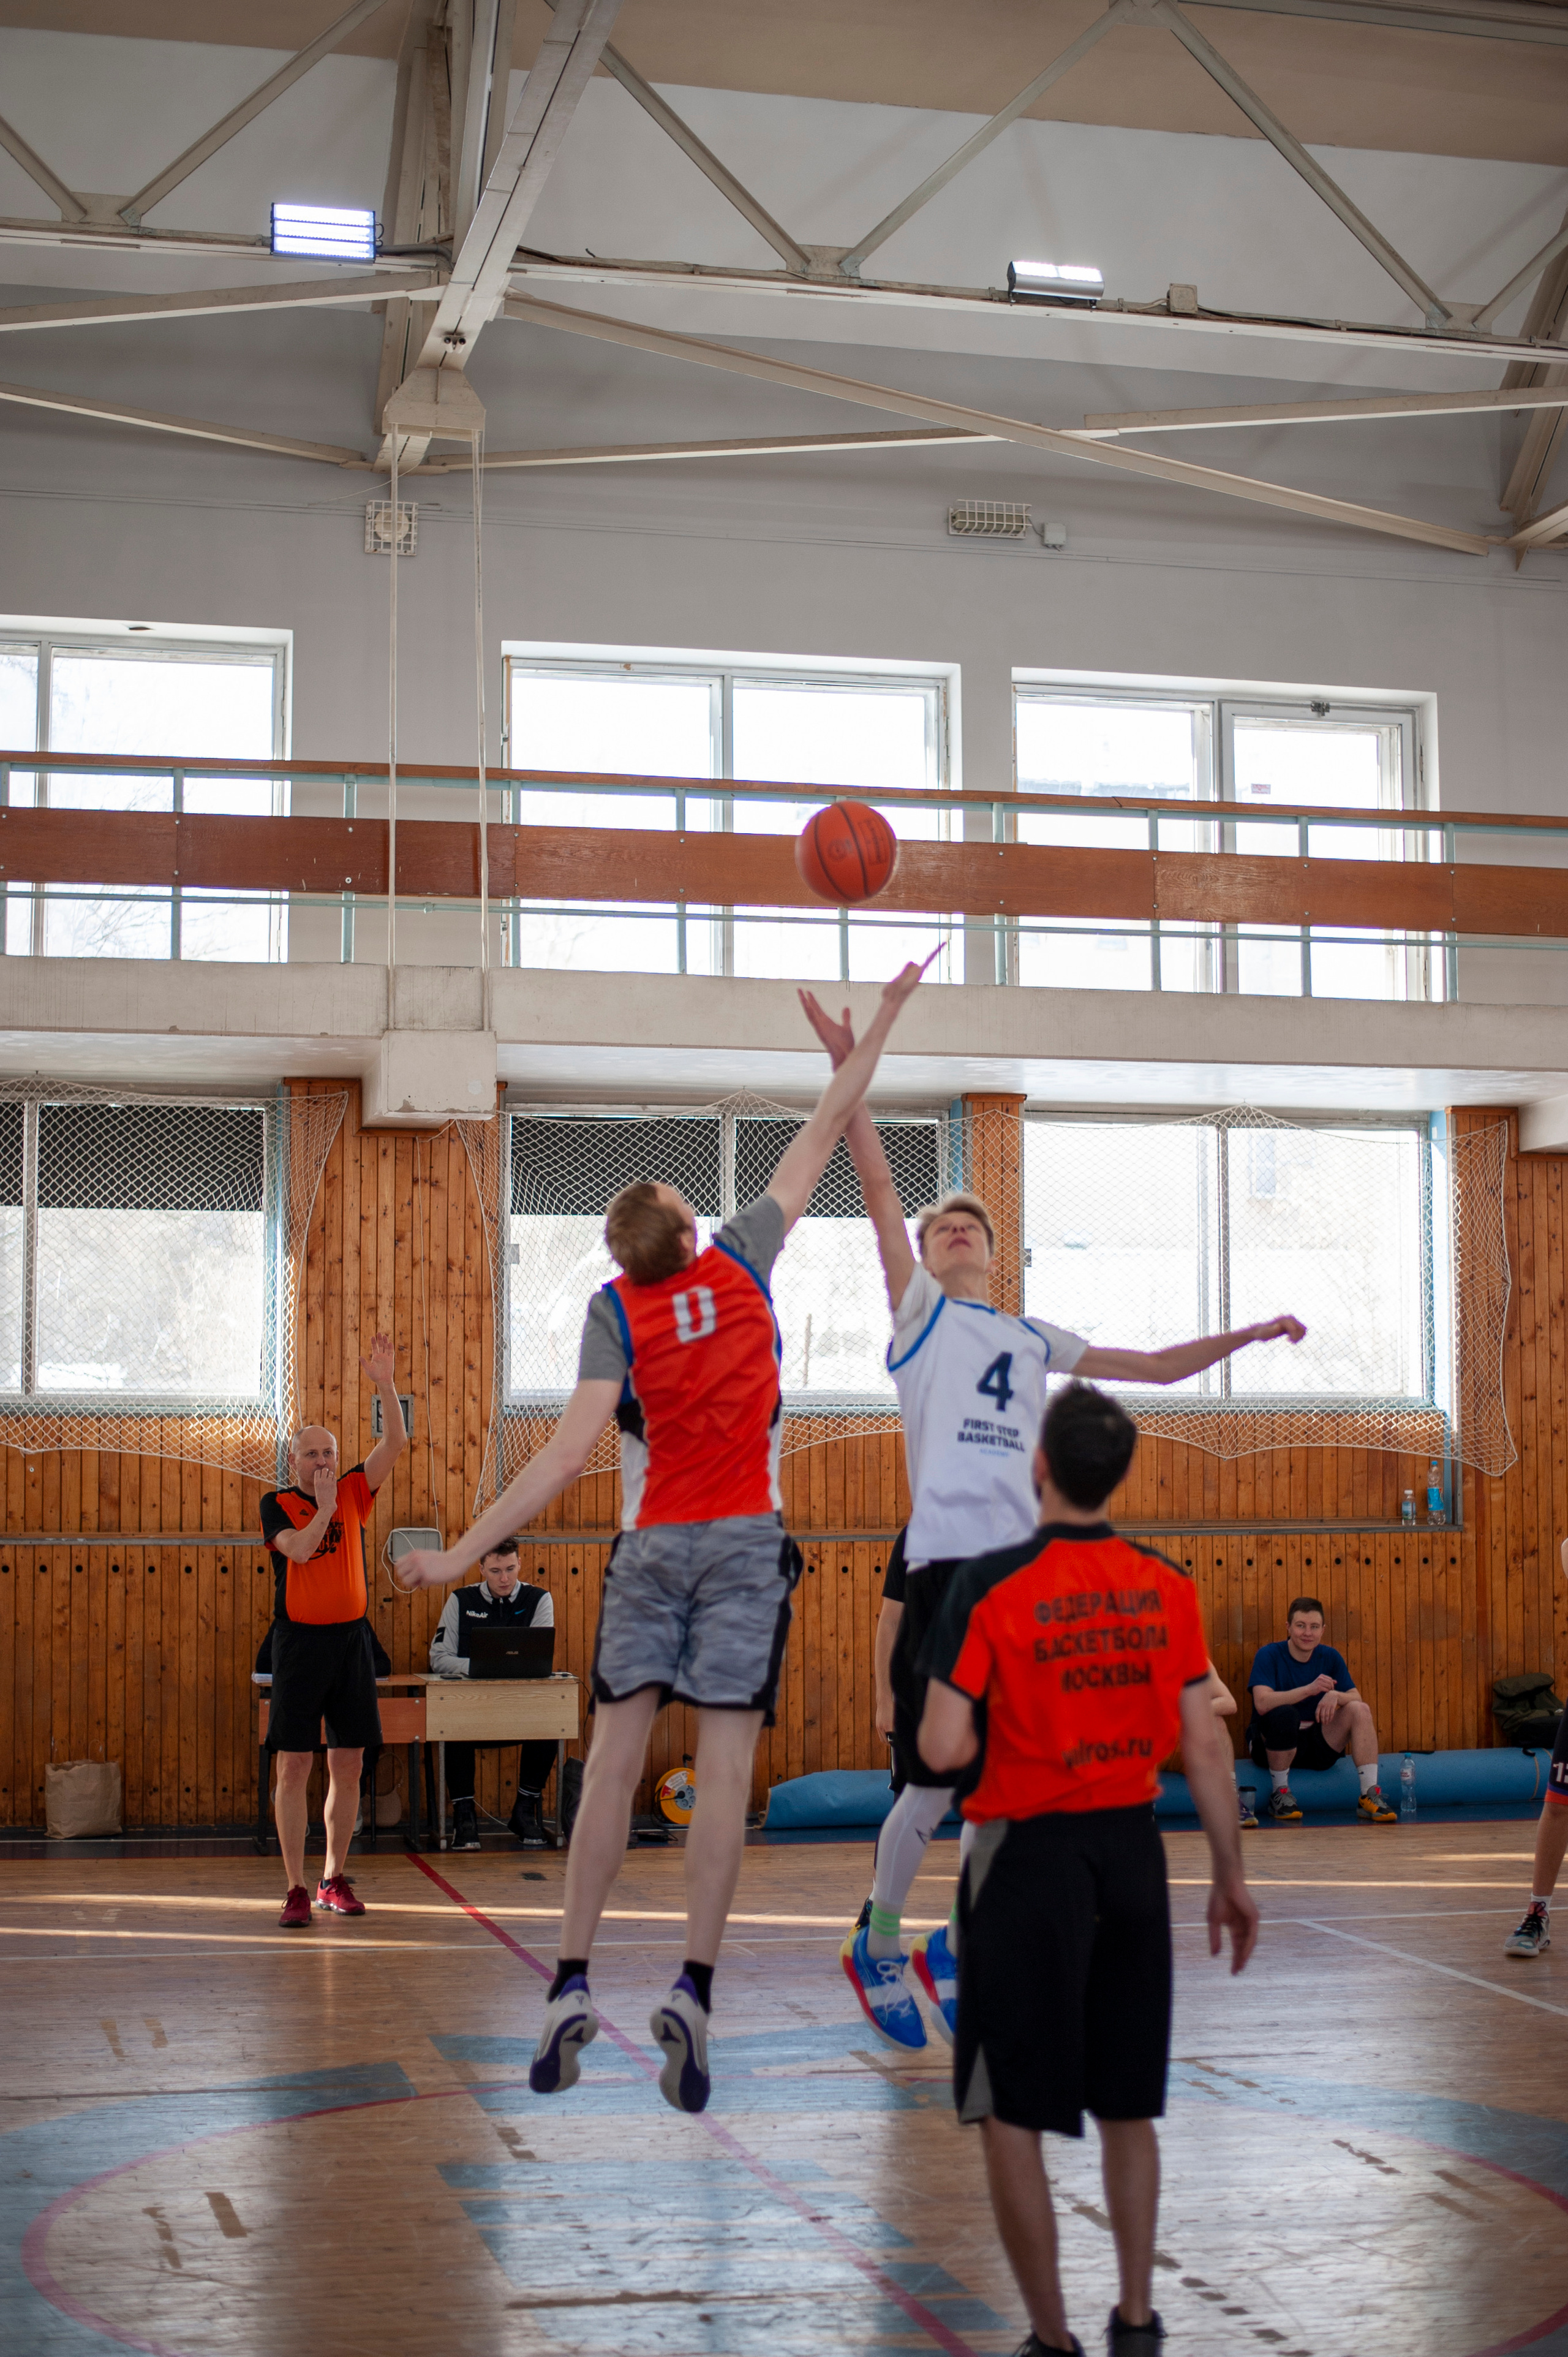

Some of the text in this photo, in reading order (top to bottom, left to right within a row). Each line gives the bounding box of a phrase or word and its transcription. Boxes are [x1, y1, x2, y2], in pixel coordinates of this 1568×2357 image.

[977, 1351, 1014, 1412] 4
[957, 1431, 1025, 1453] BASKETBALL
[963, 1418, 1019, 1438] FIRST STEP
[1033, 1589, 1163, 1625] ФЕДЕРАЦИЯ
[1033, 1625, 1168, 1663] БАСКЕТБОЛА
